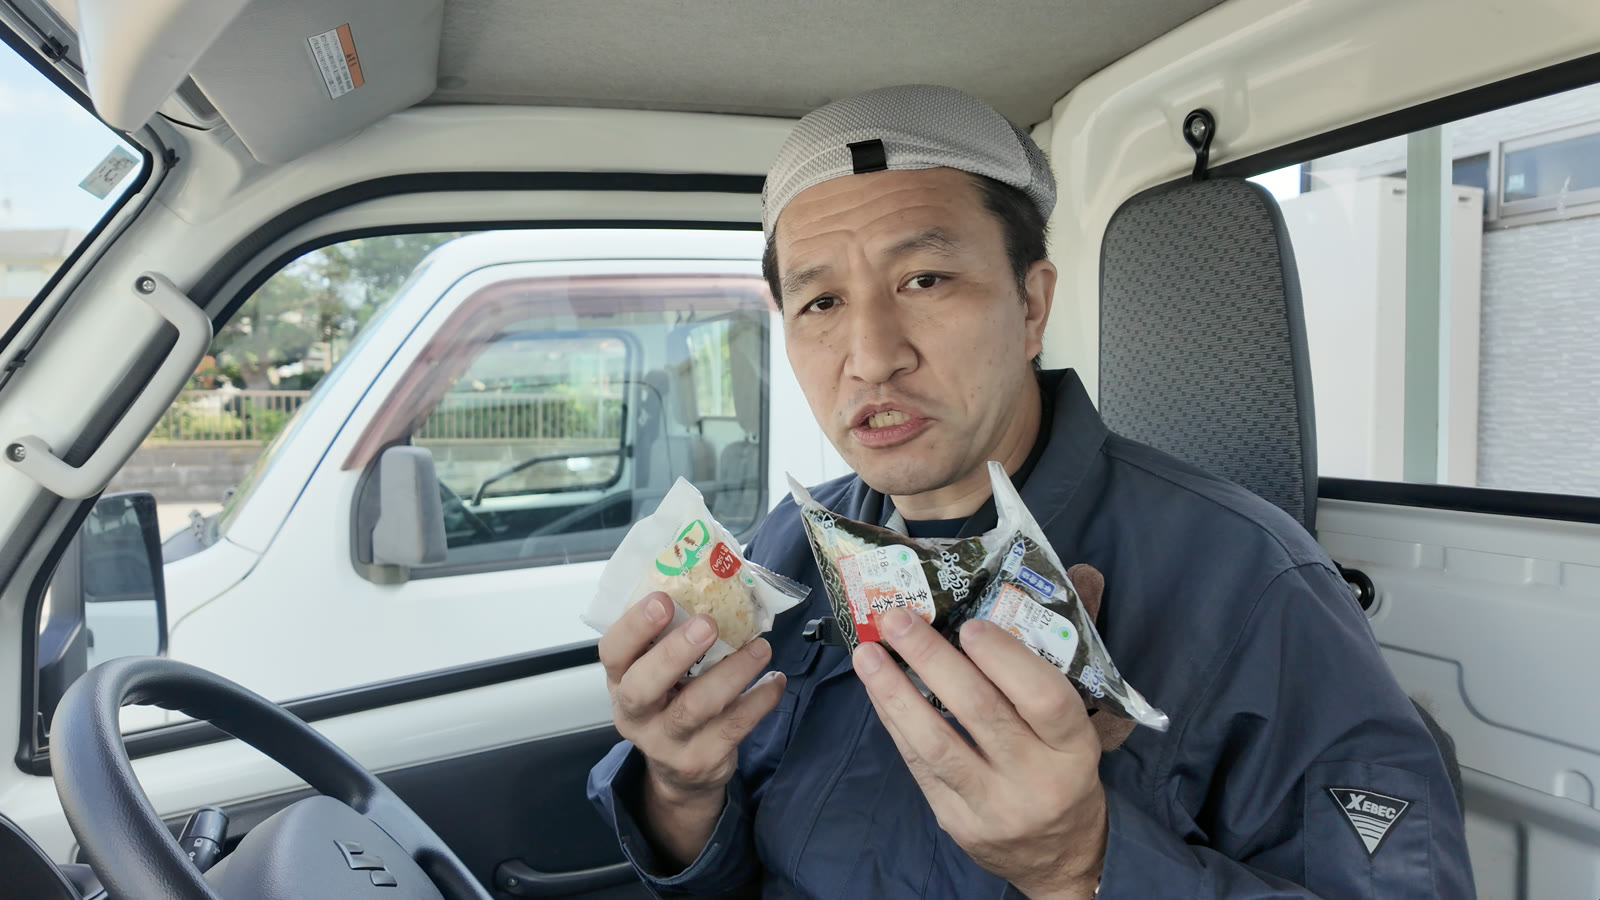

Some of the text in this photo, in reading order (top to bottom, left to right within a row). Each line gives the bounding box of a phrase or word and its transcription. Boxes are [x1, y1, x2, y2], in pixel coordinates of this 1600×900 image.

[1012, 547, 1023, 557] 3
[942, 553, 968, 600] ふわうま
[872, 588, 927, 613] 辛子明太子
[1346, 793, 1397, 819] XEBEC
